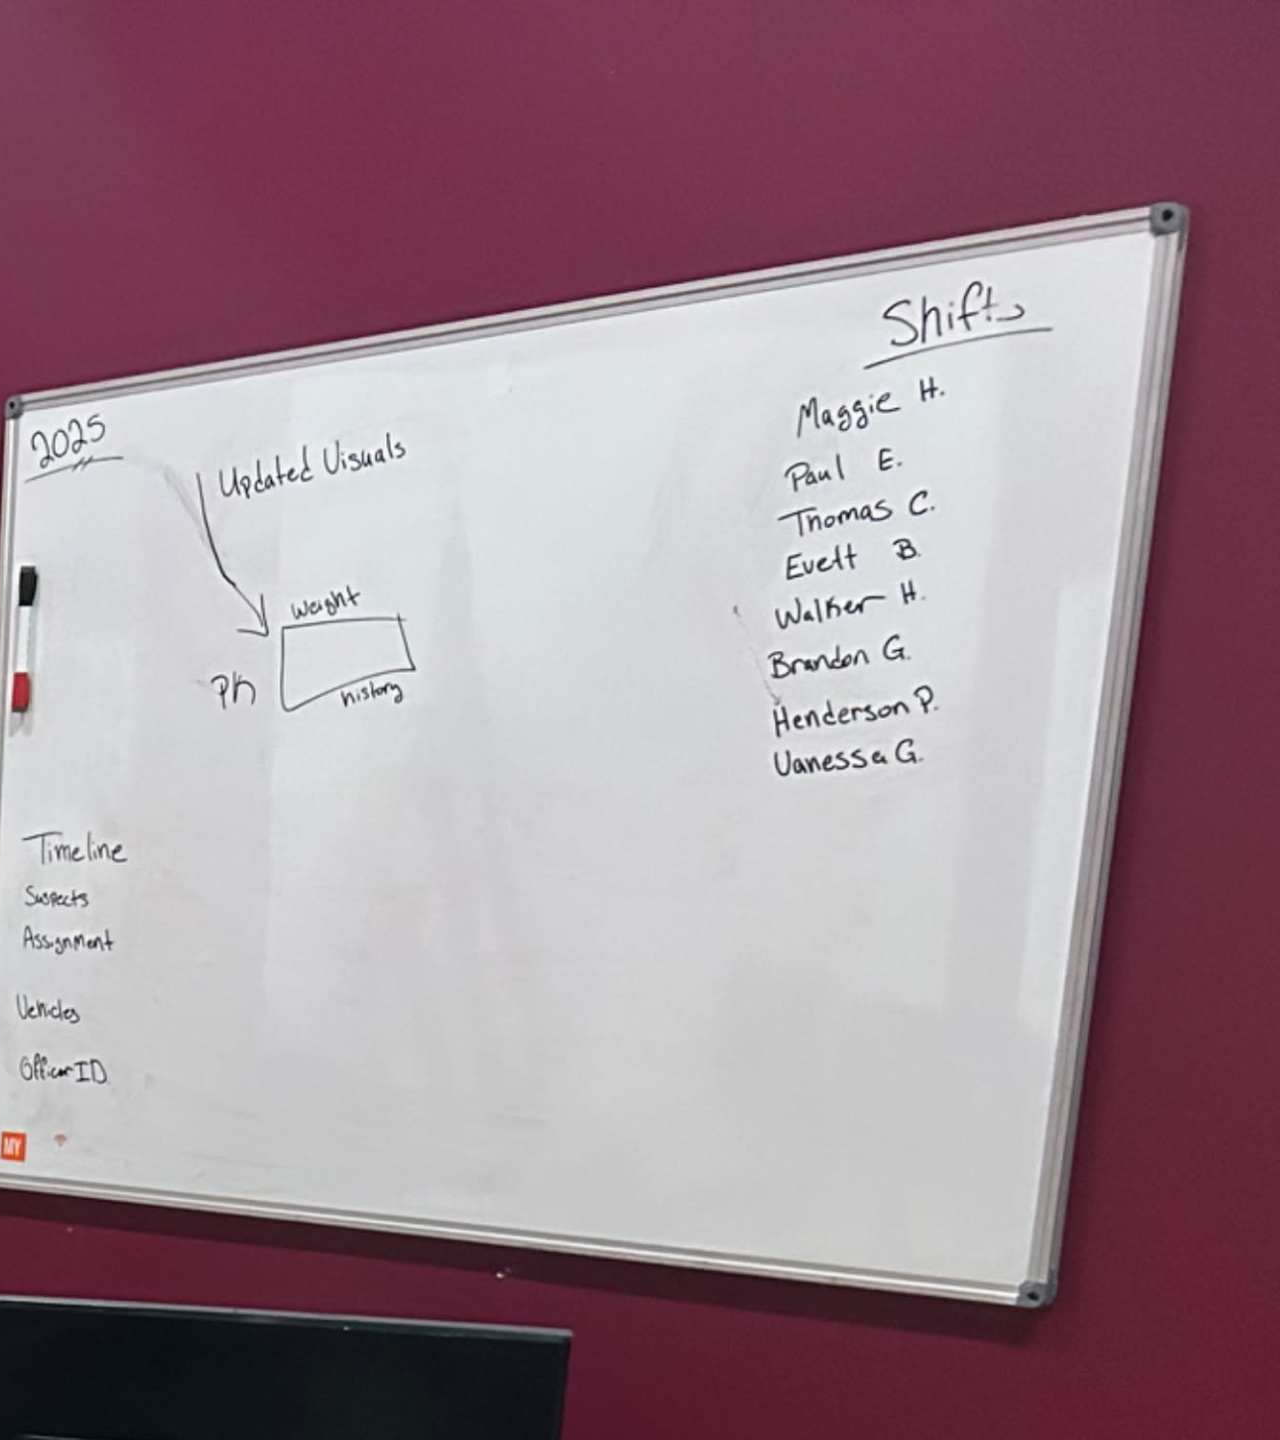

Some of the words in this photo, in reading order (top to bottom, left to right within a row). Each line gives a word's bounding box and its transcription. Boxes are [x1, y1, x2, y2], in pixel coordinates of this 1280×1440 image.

[882, 281, 1026, 347] Shifts
[796, 391, 902, 438] Maggie
[918, 376, 946, 402] H.
[31, 413, 107, 469] 2025
[218, 445, 314, 499] Updated
[322, 432, 407, 475] Visuals
[784, 453, 845, 492] Paul
[877, 447, 903, 472] E.
[777, 498, 893, 537] Thomas
[908, 489, 936, 516] C.
[892, 537, 922, 561] B.
[774, 595, 887, 630] Walker
[899, 579, 927, 605] H.
[768, 644, 871, 679] Brandon
[882, 633, 912, 661] G.
[773, 698, 911, 738] Henderson
[912, 684, 940, 714] P.
[774, 748, 888, 777] Vanessa
[894, 738, 925, 764] G.
[22, 831, 129, 865] Timeline
[25, 885, 90, 908] Suspects
[16, 993, 81, 1024] Vehicles
